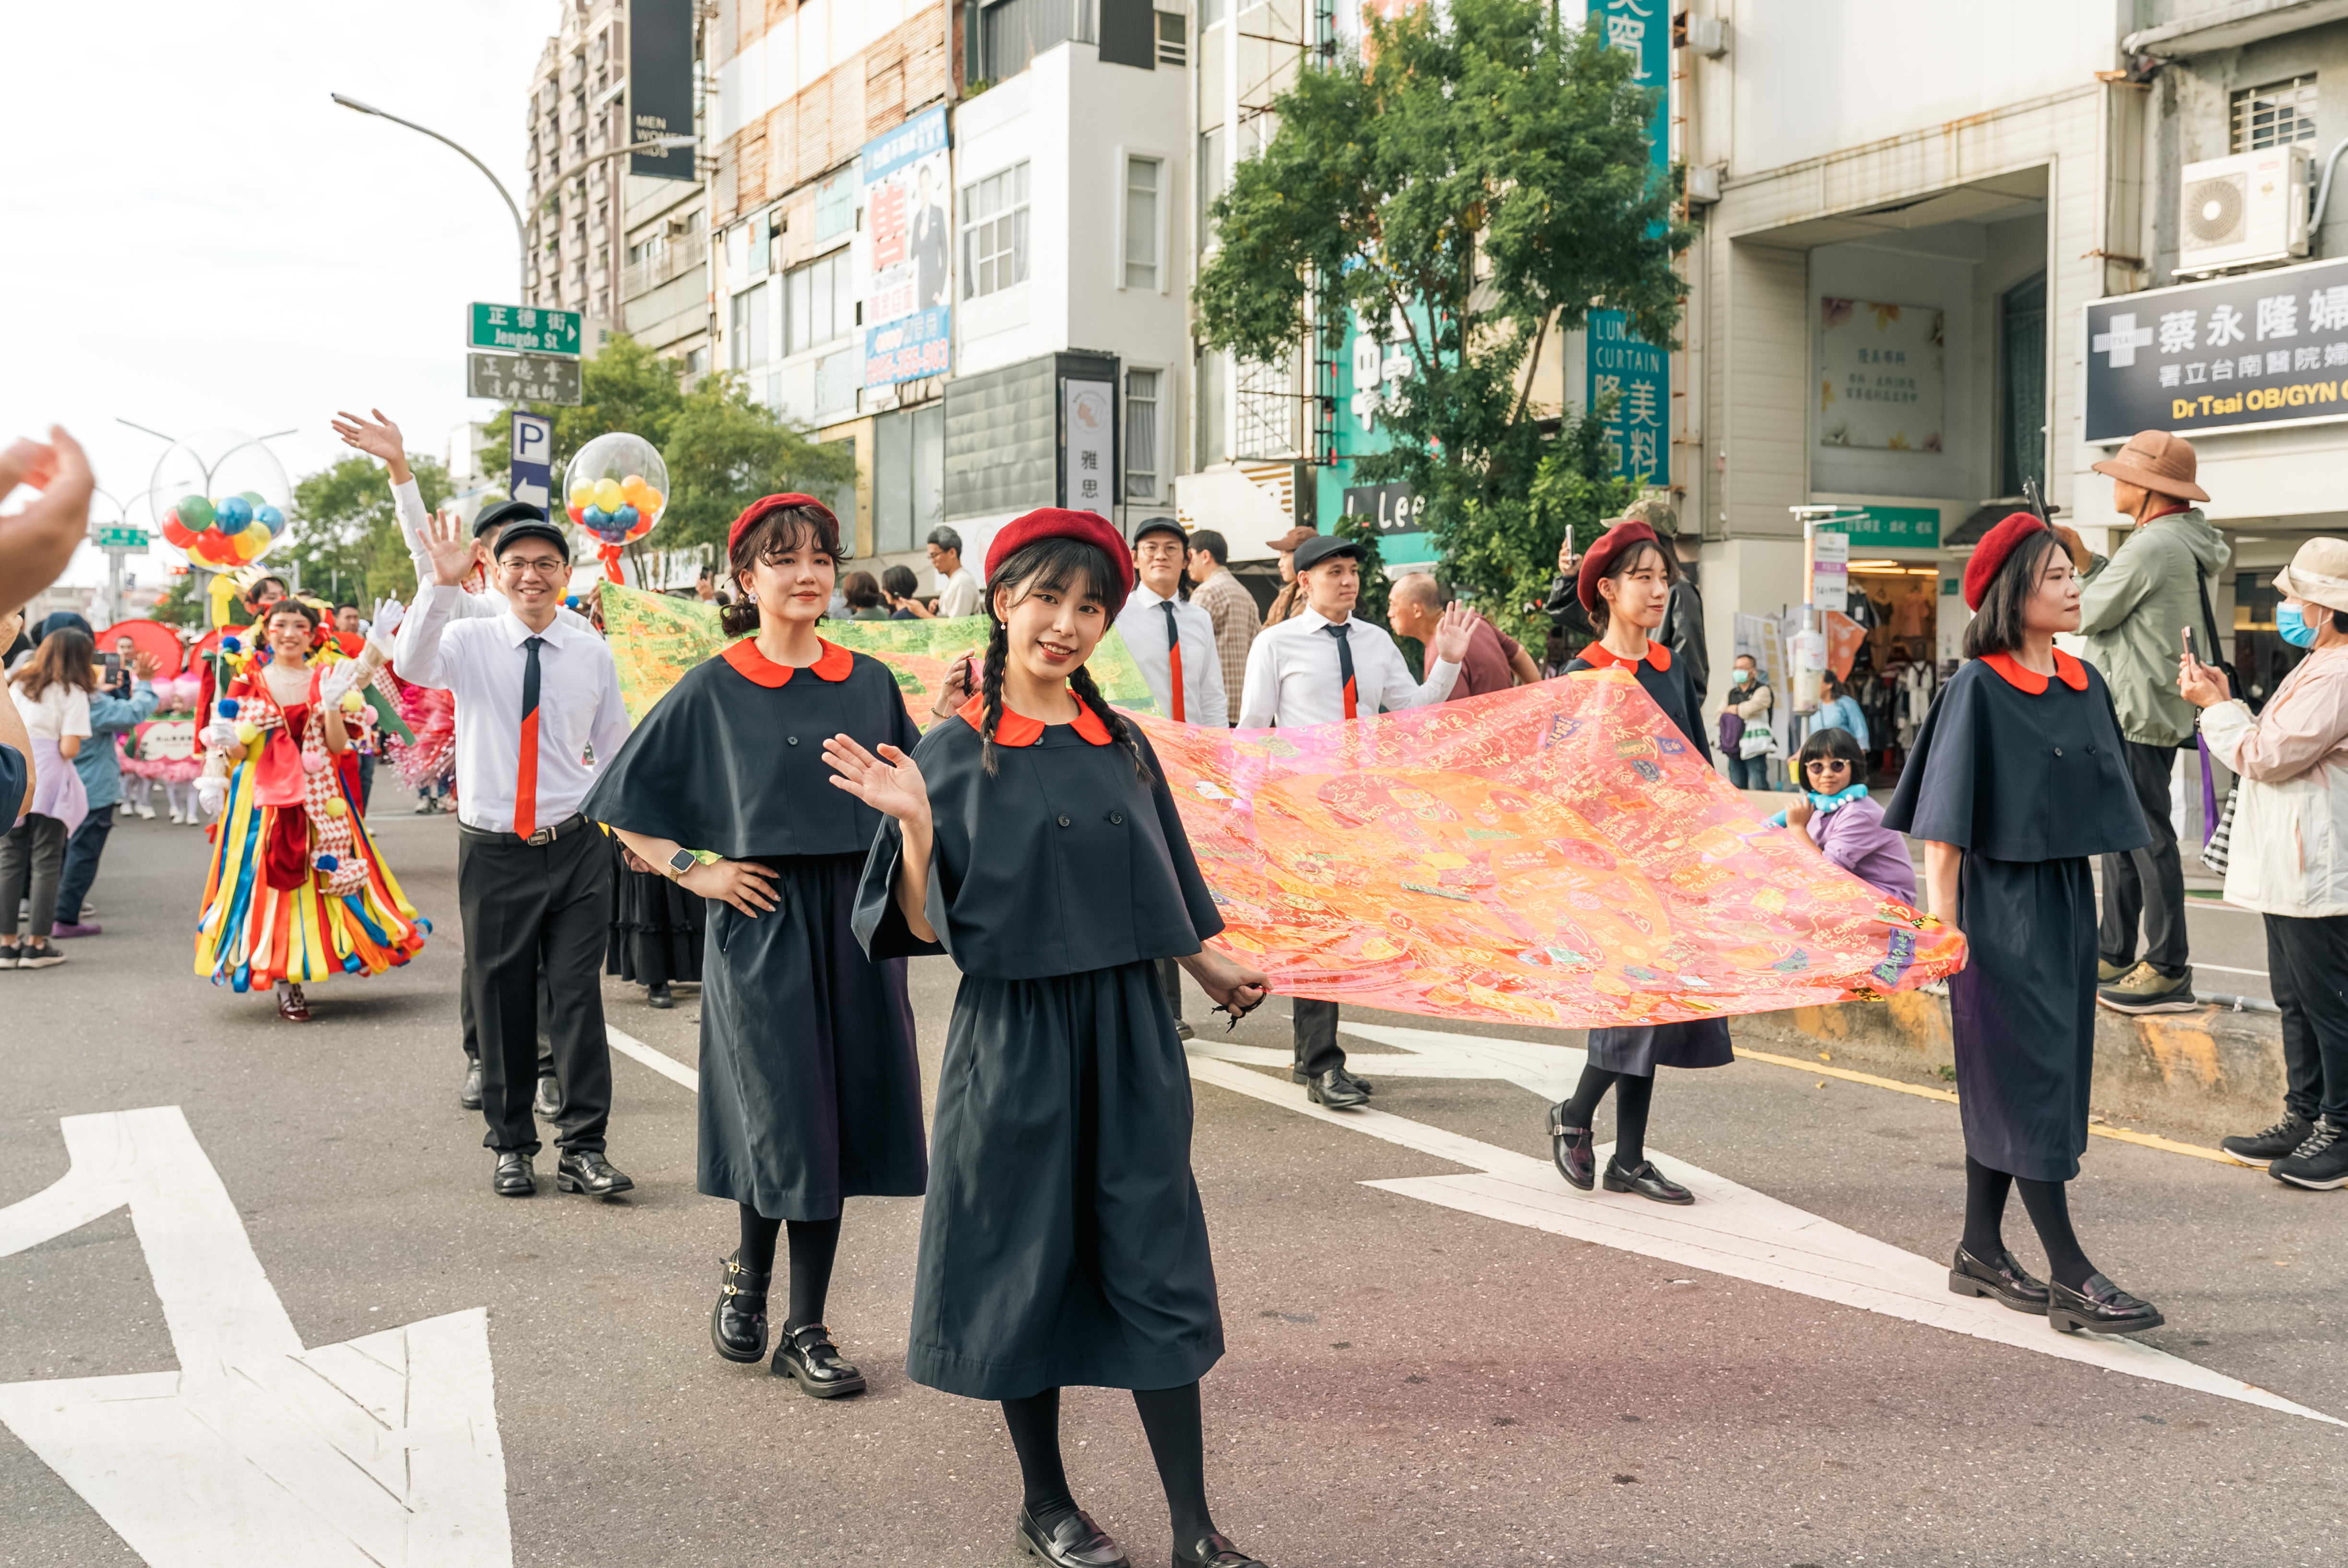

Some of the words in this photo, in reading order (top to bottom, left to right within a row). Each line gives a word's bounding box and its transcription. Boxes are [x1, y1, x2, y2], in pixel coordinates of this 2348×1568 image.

[636, 115, 666, 130] MEN
[487, 306, 567, 332] 正德街
[2159, 285, 2348, 354] 蔡永隆婦
[494, 328, 539, 350] Jengde
[481, 356, 563, 382] 正德堂
[1596, 347, 1660, 373] CURTAIN
[2158, 341, 2348, 388] 署立台南醫院婦
[2172, 398, 2197, 419] Dr
[2197, 392, 2243, 415] Tsai
[2245, 381, 2338, 411] OB/GYN
[520, 423, 543, 454] P
[1081, 450, 1098, 512] 雅思
[1686, 870, 1728, 893] TWICE
